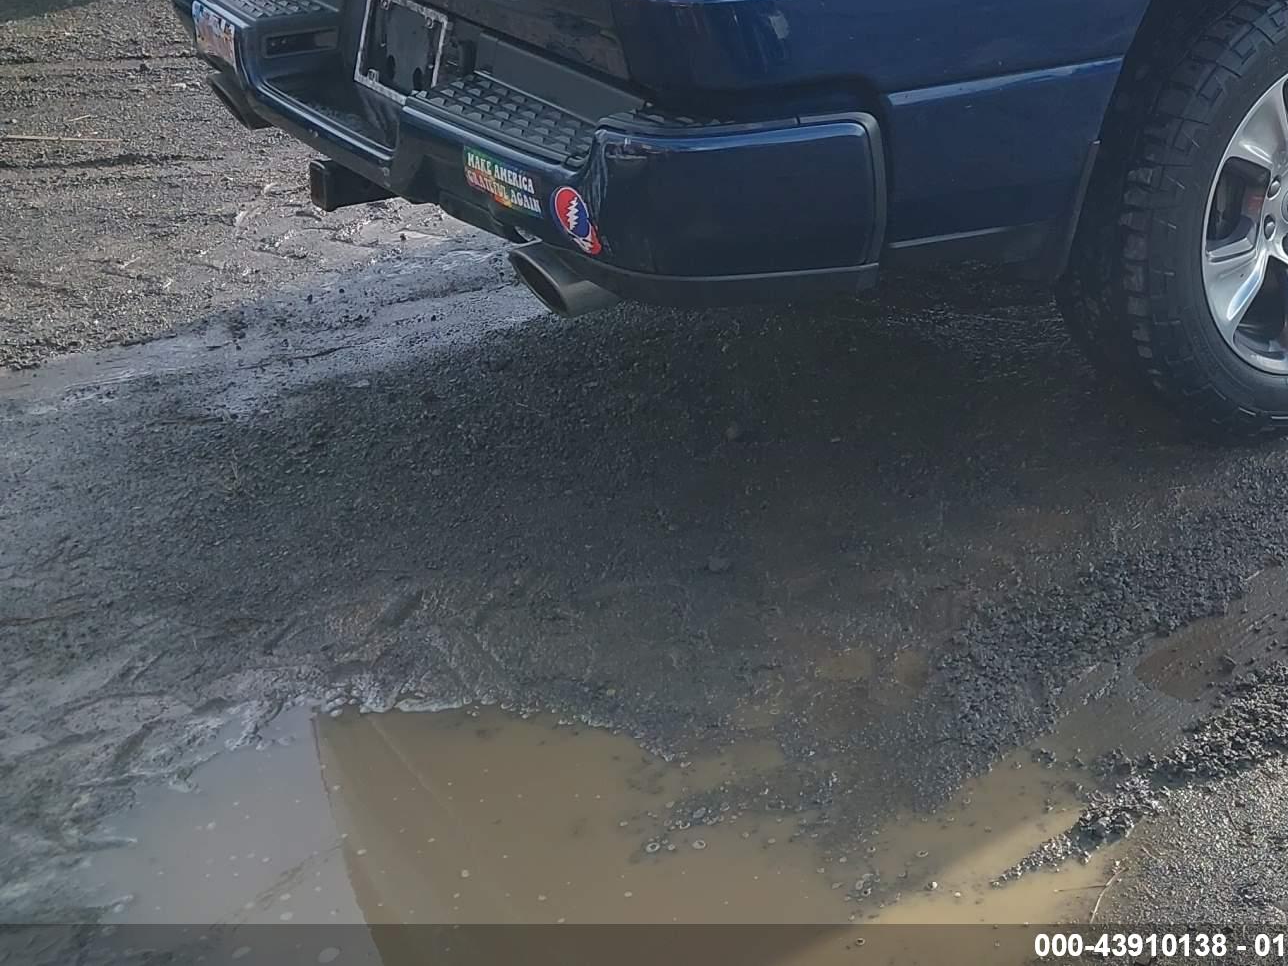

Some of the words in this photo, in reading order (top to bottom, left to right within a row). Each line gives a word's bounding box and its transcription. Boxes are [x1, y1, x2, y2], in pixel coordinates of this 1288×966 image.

[467, 152, 492, 173] MAKE
[494, 165, 535, 194] AMERICA
[510, 189, 542, 213] AGAIN
